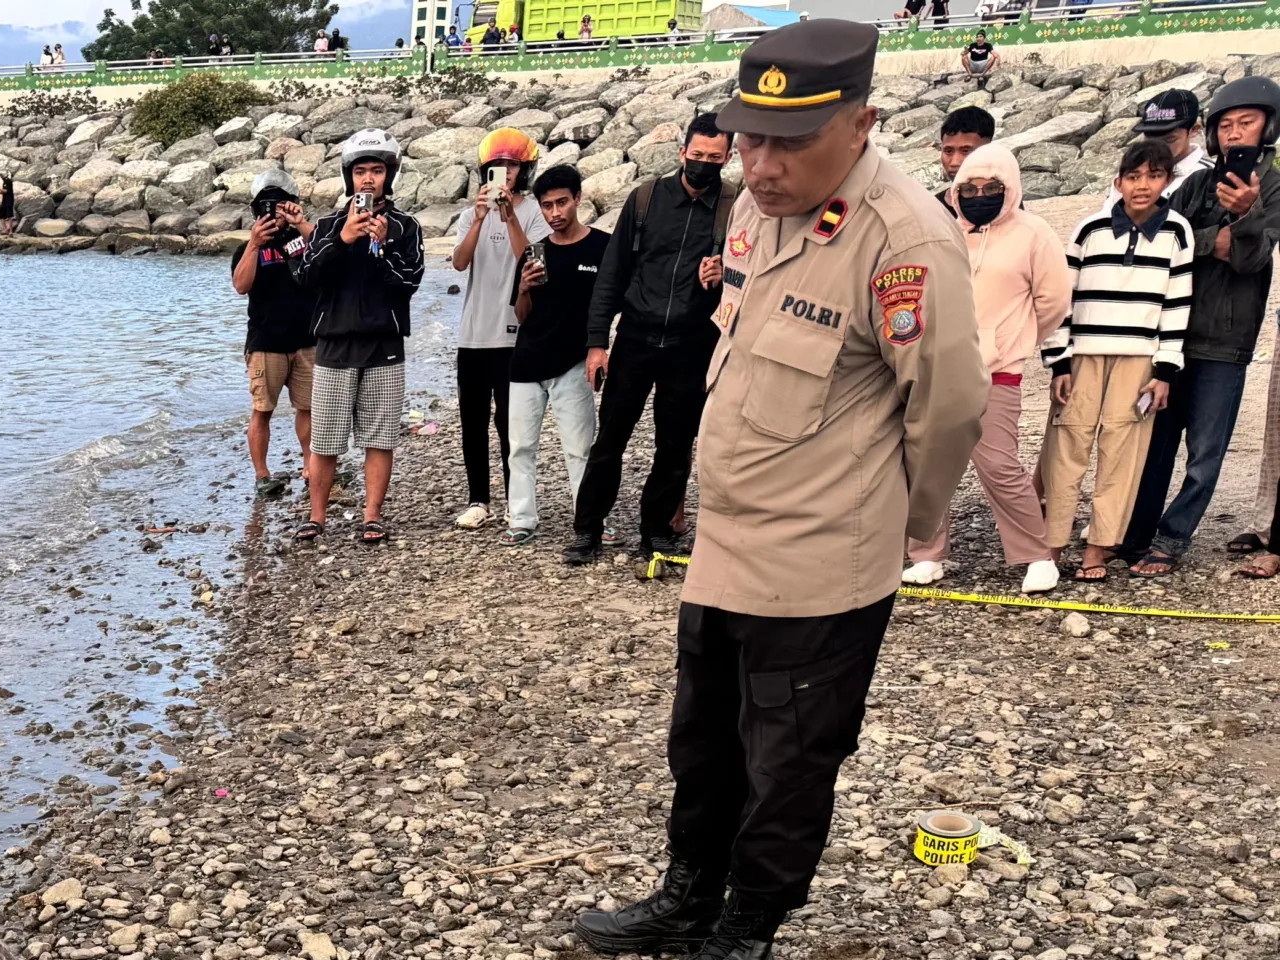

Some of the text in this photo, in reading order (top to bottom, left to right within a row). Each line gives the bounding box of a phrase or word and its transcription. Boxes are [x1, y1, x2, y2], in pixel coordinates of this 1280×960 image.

[875, 267, 923, 288] POLRES
[884, 273, 915, 289] PALU
[779, 294, 843, 329] POLRI
[923, 835, 959, 852] GARIS
[924, 849, 966, 864] POLICE
